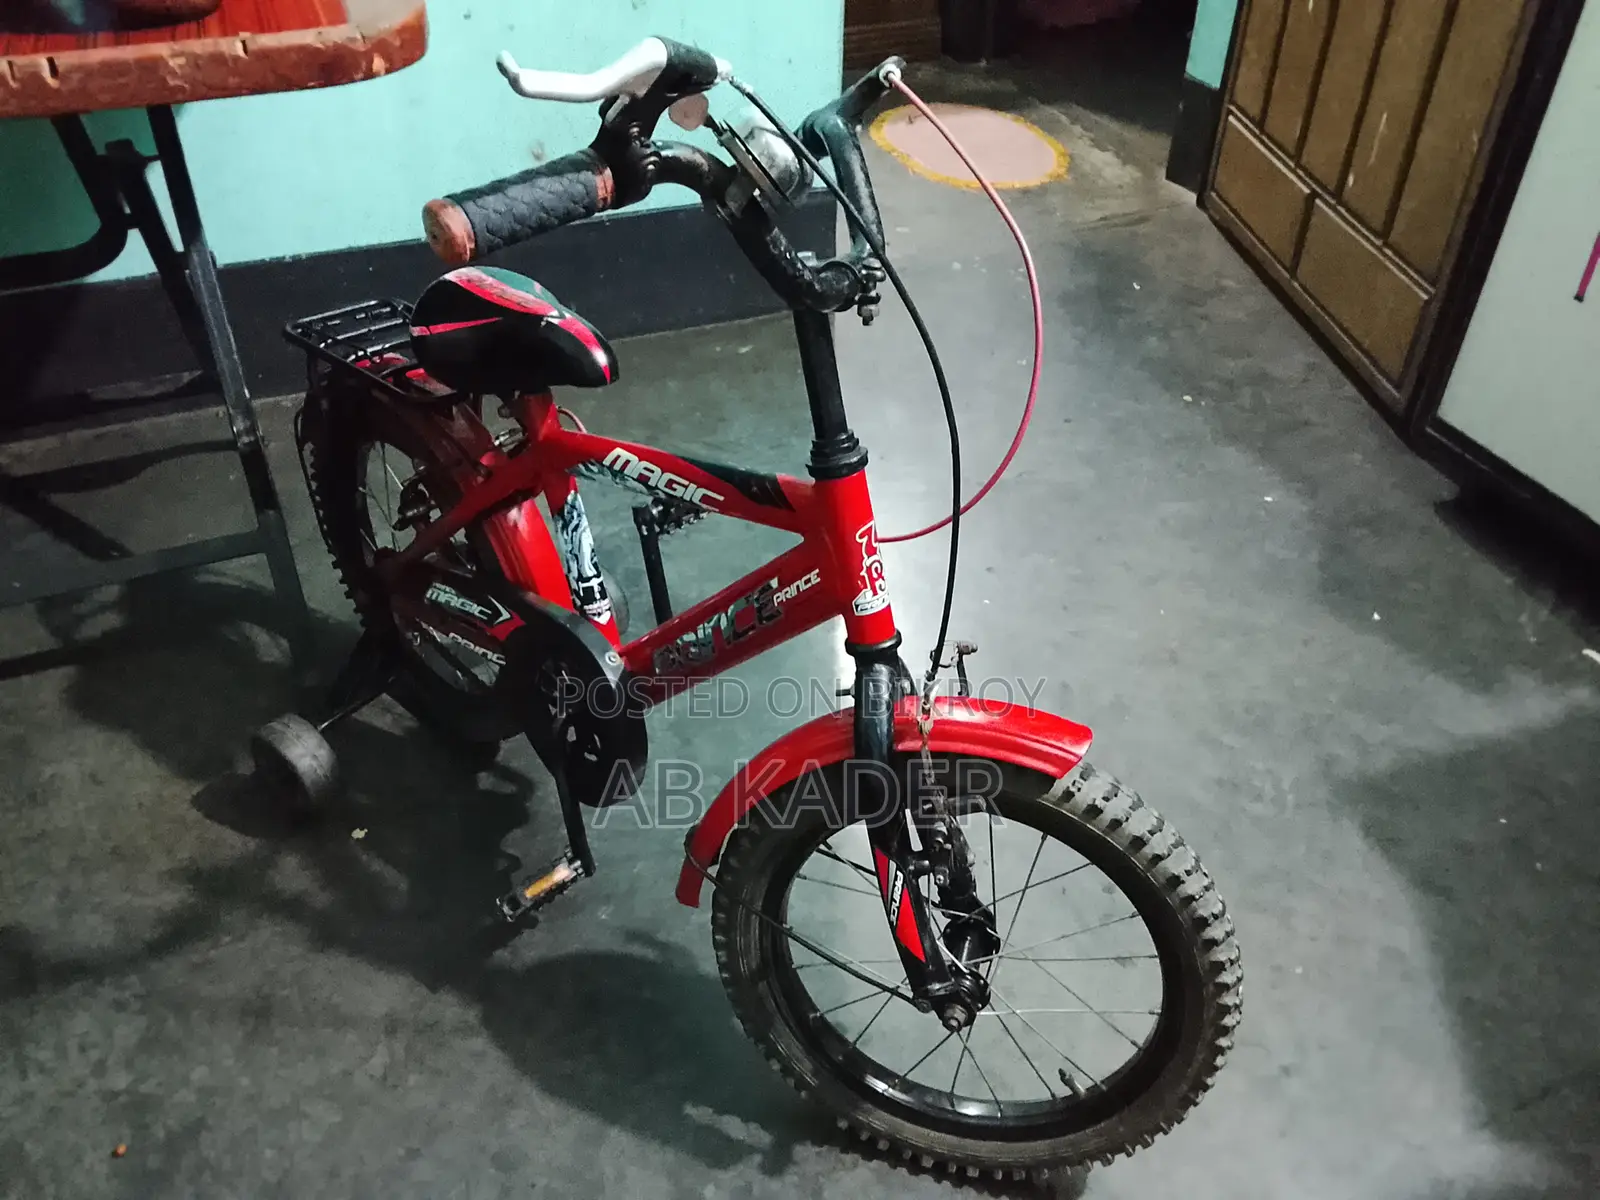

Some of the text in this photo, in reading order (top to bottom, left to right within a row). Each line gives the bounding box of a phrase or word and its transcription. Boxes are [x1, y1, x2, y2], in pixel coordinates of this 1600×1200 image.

[602, 447, 724, 512] MAGIC
[425, 587, 492, 620] MAGIC
[773, 568, 821, 607] PRINCE
